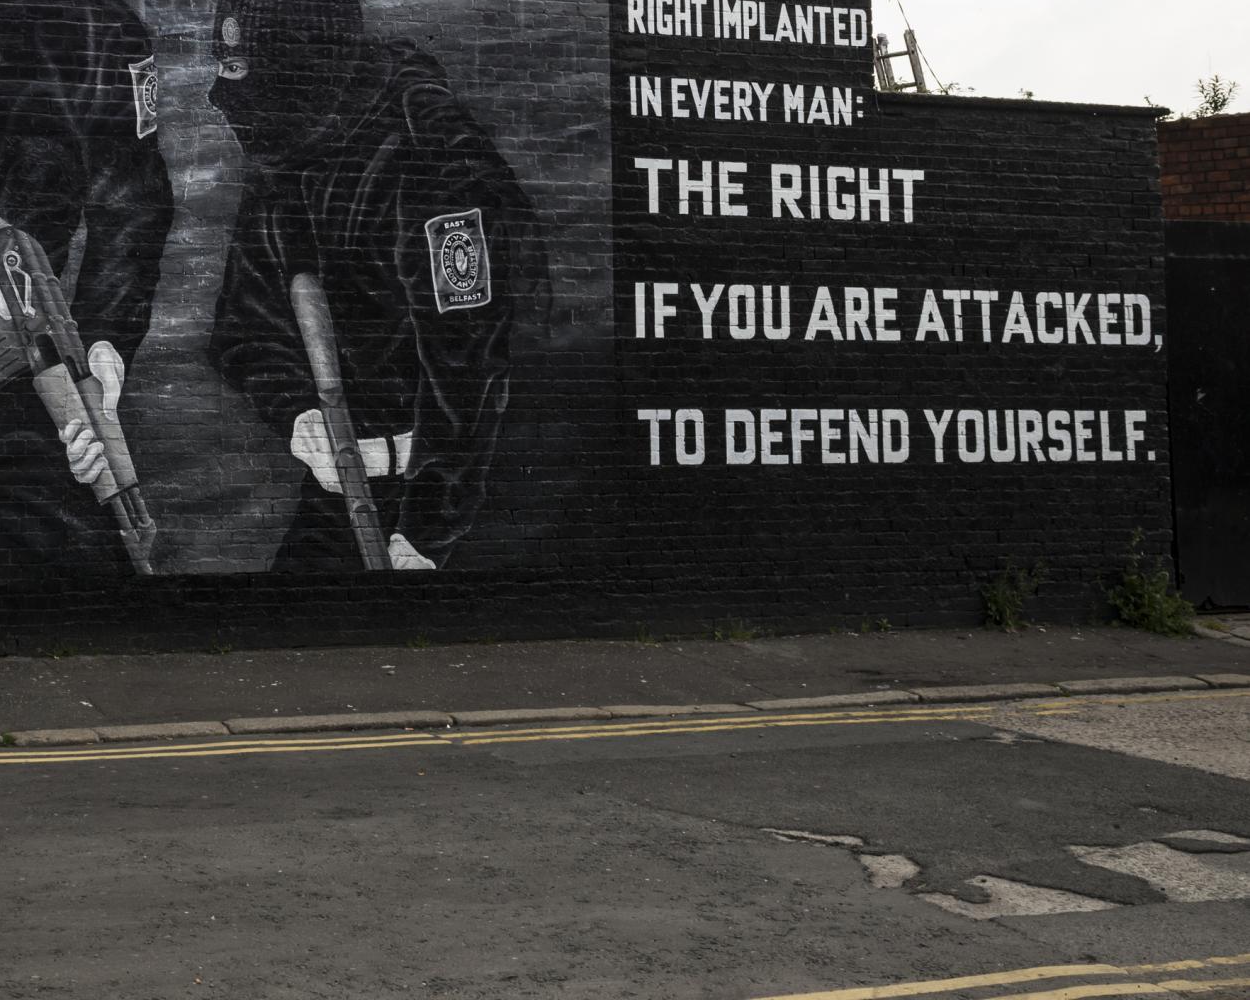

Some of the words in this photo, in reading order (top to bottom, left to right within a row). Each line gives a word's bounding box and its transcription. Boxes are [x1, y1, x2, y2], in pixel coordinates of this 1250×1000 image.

[630, 75, 663, 118] IN
[670, 77, 775, 122] EVERY
[783, 83, 865, 127] MAN:
[635, 157, 749, 217] THE
[771, 163, 925, 225] RIGHT
[444, 220, 465, 229] EAST
[446, 267, 458, 283] GOD
[456, 278, 474, 288] AND
[449, 293, 482, 302] BELFAST
[634, 283, 678, 339] IF
[690, 284, 791, 340] YOU
[805, 286, 901, 342] ARE
[915, 289, 1163, 352] ATTACKED,
[637, 409, 706, 466] TO
[726, 409, 910, 465] DEFEND
[924, 409, 1157, 463] YOURSELF.
